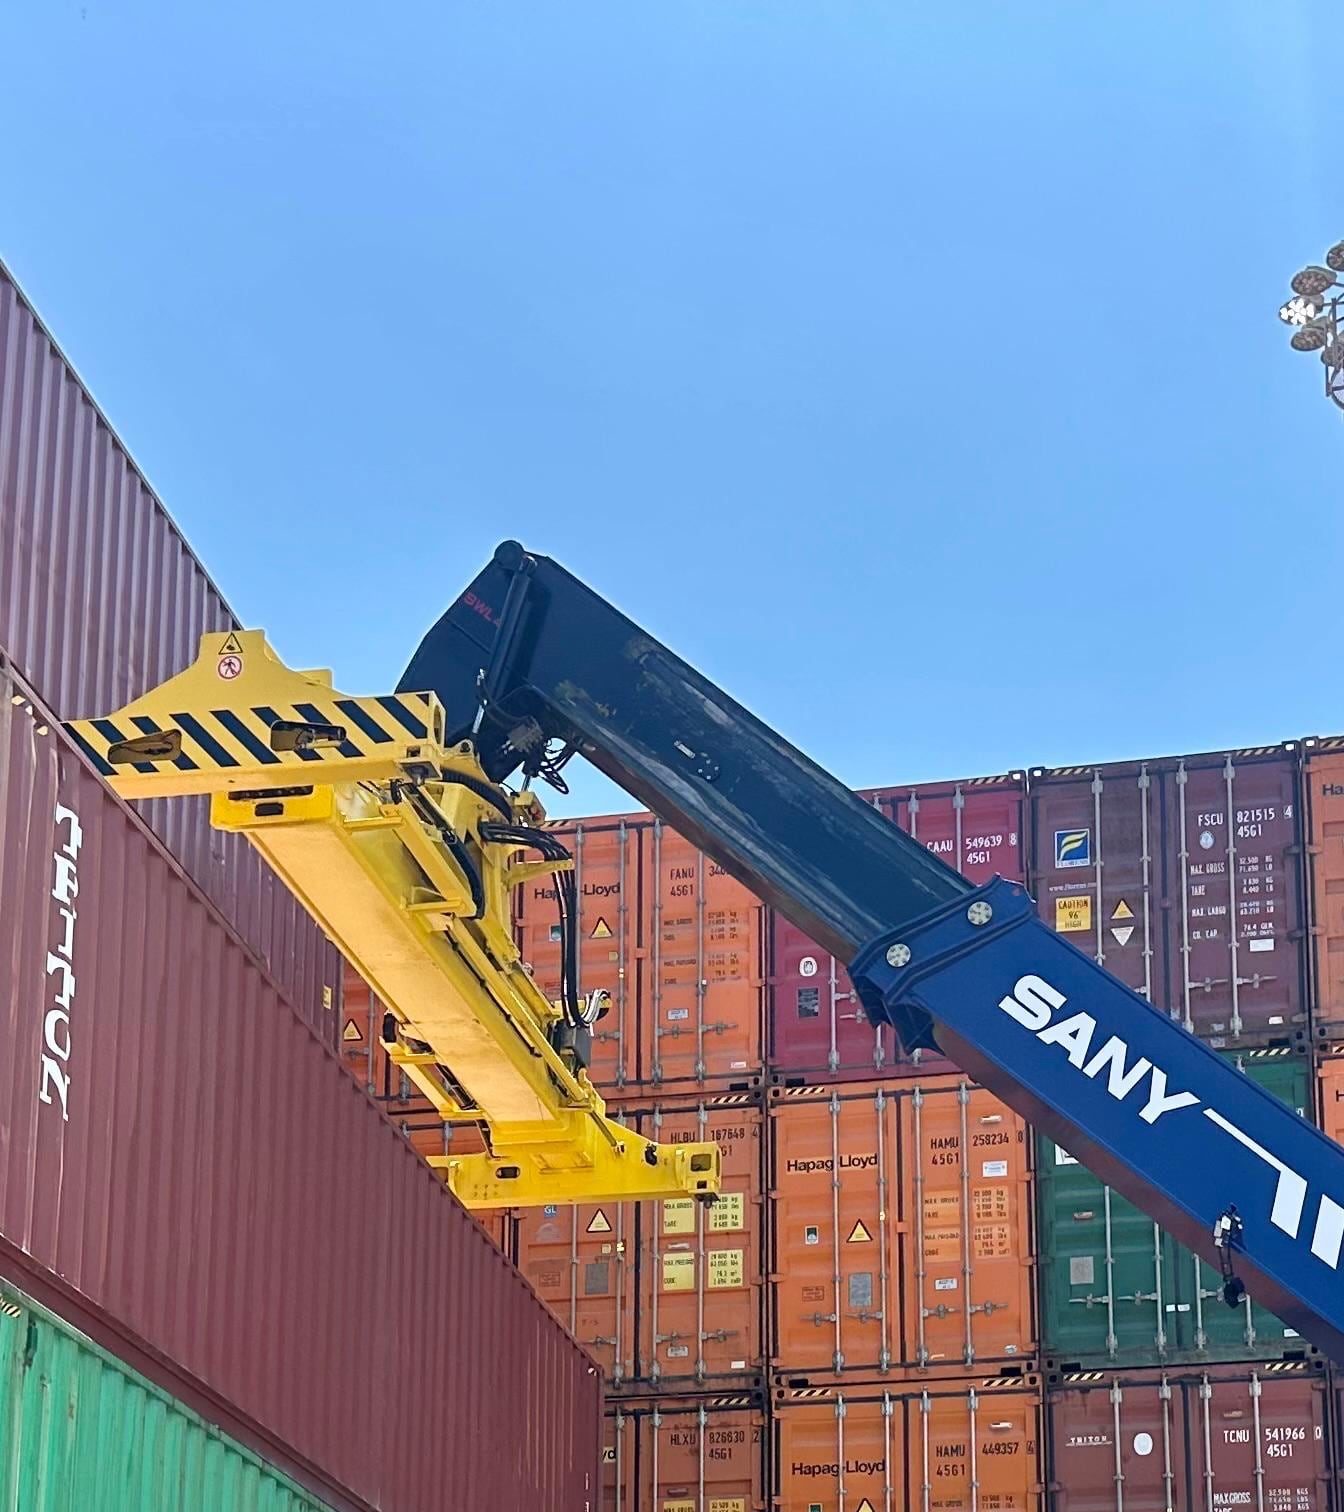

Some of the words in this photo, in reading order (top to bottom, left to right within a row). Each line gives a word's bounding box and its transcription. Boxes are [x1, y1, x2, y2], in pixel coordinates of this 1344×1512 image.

[1198, 813, 1224, 827] FSCU
[1237, 808, 1276, 823] 821515
[1237, 824, 1263, 838] 45G1
[966, 834, 1002, 849] 549639
[967, 850, 990, 864] 45G1
[670, 867, 695, 881] FANU
[670, 884, 694, 897] 45G1
[40, 803, 84, 1122] TRITON
[998, 975, 1201, 1125] SANY
[787, 1153, 879, 1174] HapagLloyd
[931, 1152, 960, 1165] 45G1
[1224, 1429, 1250, 1443] TCNU
[1265, 1426, 1306, 1441] 541966
[936, 1446, 966, 1457] HAMU
[982, 1441, 1018, 1455] 449357
[1267, 1443, 1293, 1457] 45G1
[936, 1464, 966, 1476] 45G1
